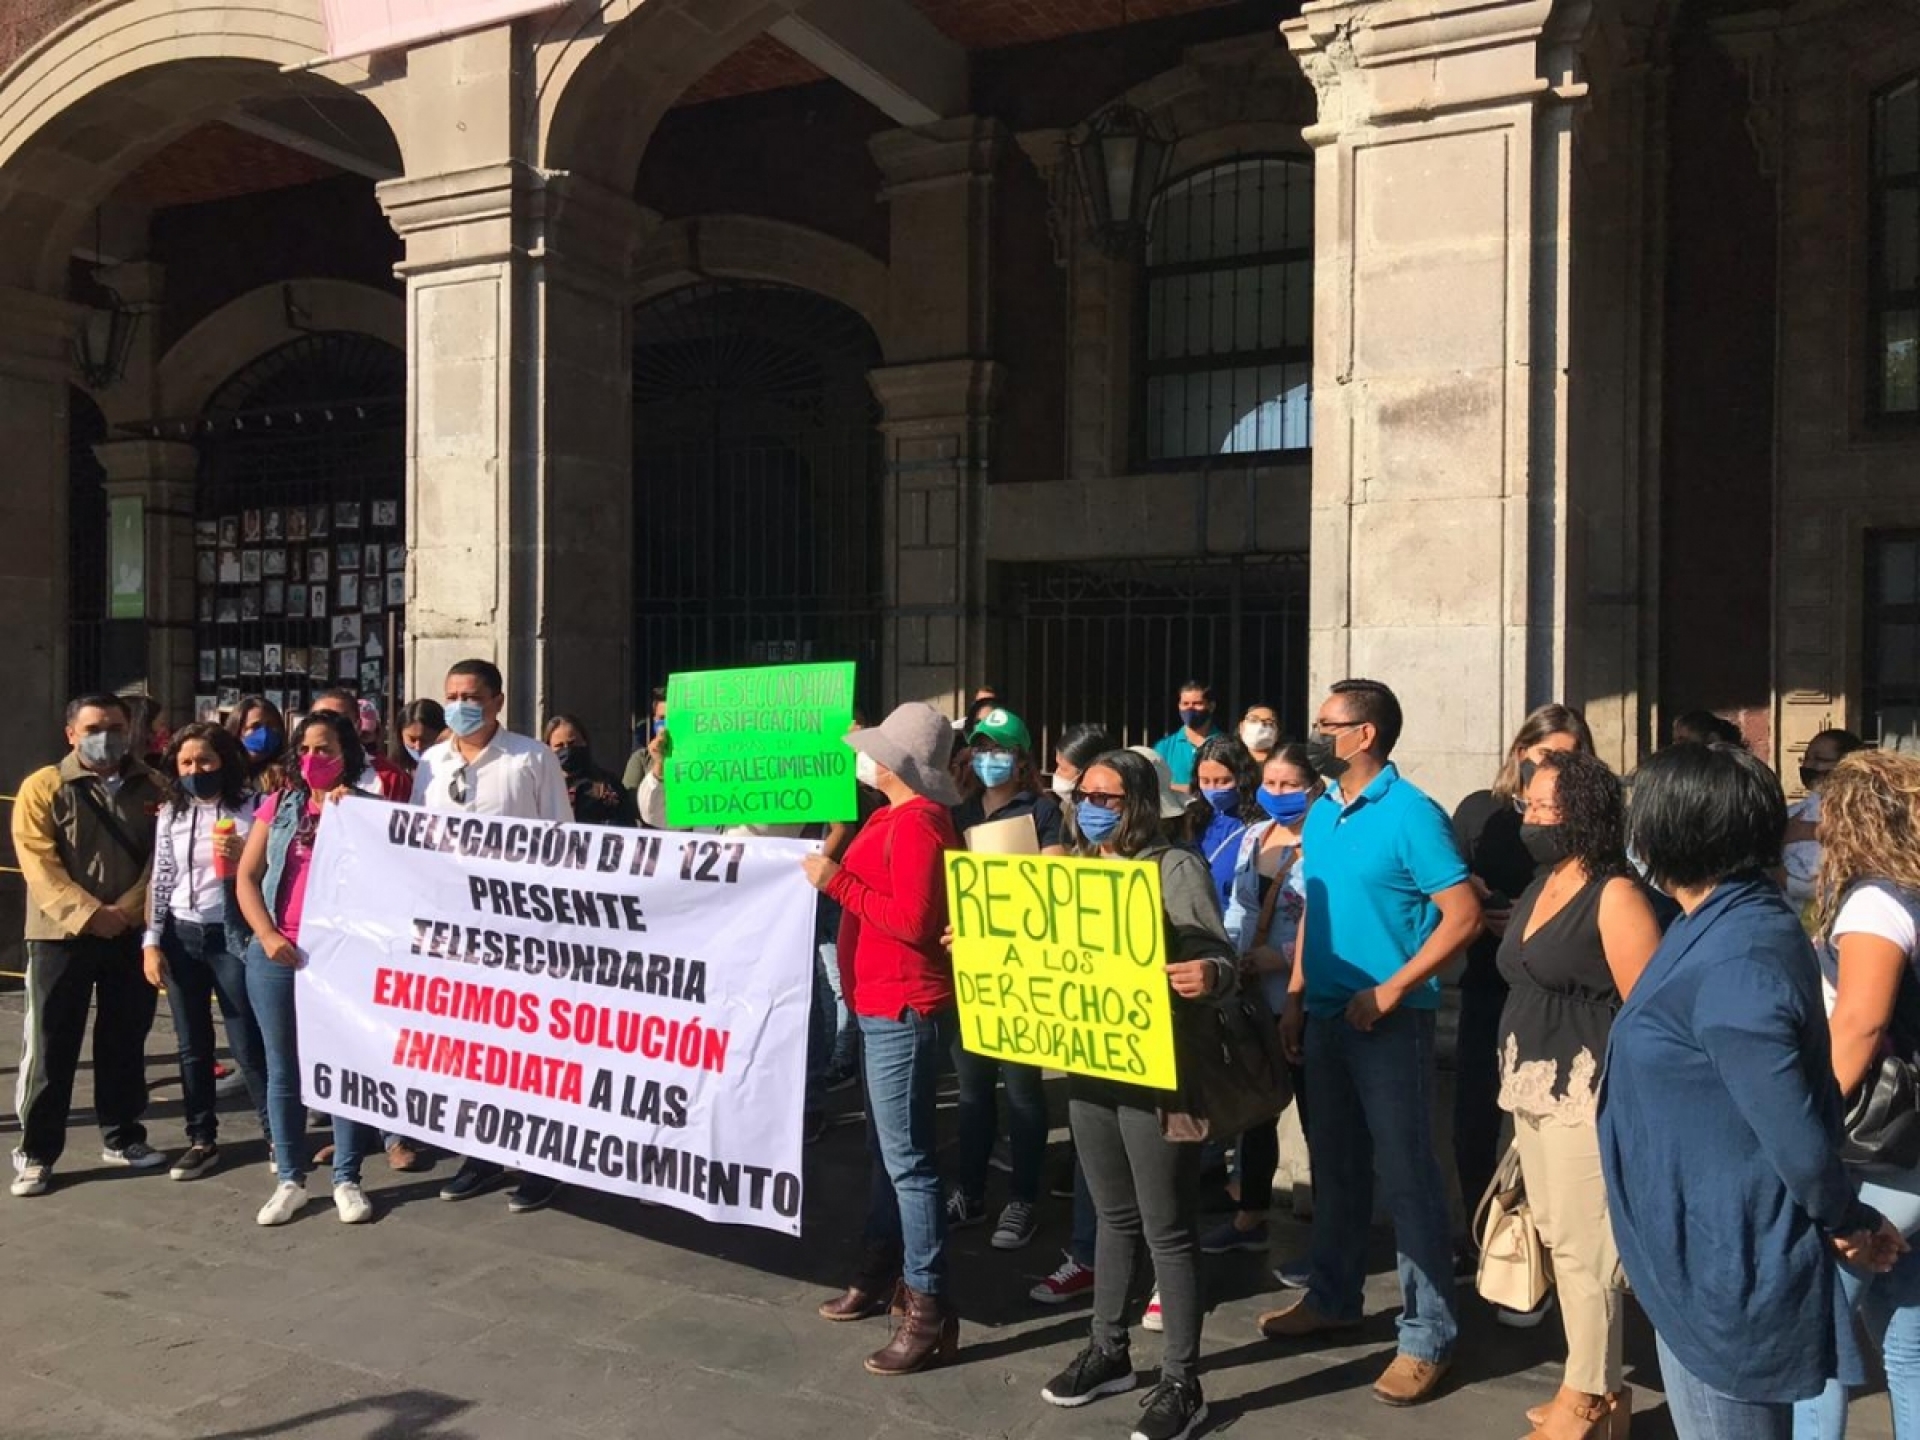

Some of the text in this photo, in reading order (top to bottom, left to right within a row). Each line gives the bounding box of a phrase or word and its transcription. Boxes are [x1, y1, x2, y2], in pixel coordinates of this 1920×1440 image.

[988, 712, 1001, 724] L
[675, 752, 846, 784] FORTALECIMIENTO
[688, 786, 813, 814] DIDÁCTICO
[388, 808, 590, 869] DELEGACIÓN
[596, 833, 624, 873] D
[679, 841, 745, 883] 127
[468, 875, 647, 931] PRESENTE
[950, 855, 1157, 967] RESPETO
[410, 917, 707, 1003] TELESECUNDARIA
[1003, 944, 1094, 975] A LOS
[372, 967, 731, 1073] EXIGIMOS SOLUCIÓN
[958, 971, 1152, 1031] DERECHOS
[976, 1015, 1147, 1076] LABORALES
[392, 1028, 689, 1128] INMEDIATA A LAS
[313, 1063, 801, 1218] 6 HRS DE FORTALECIMIENTO
